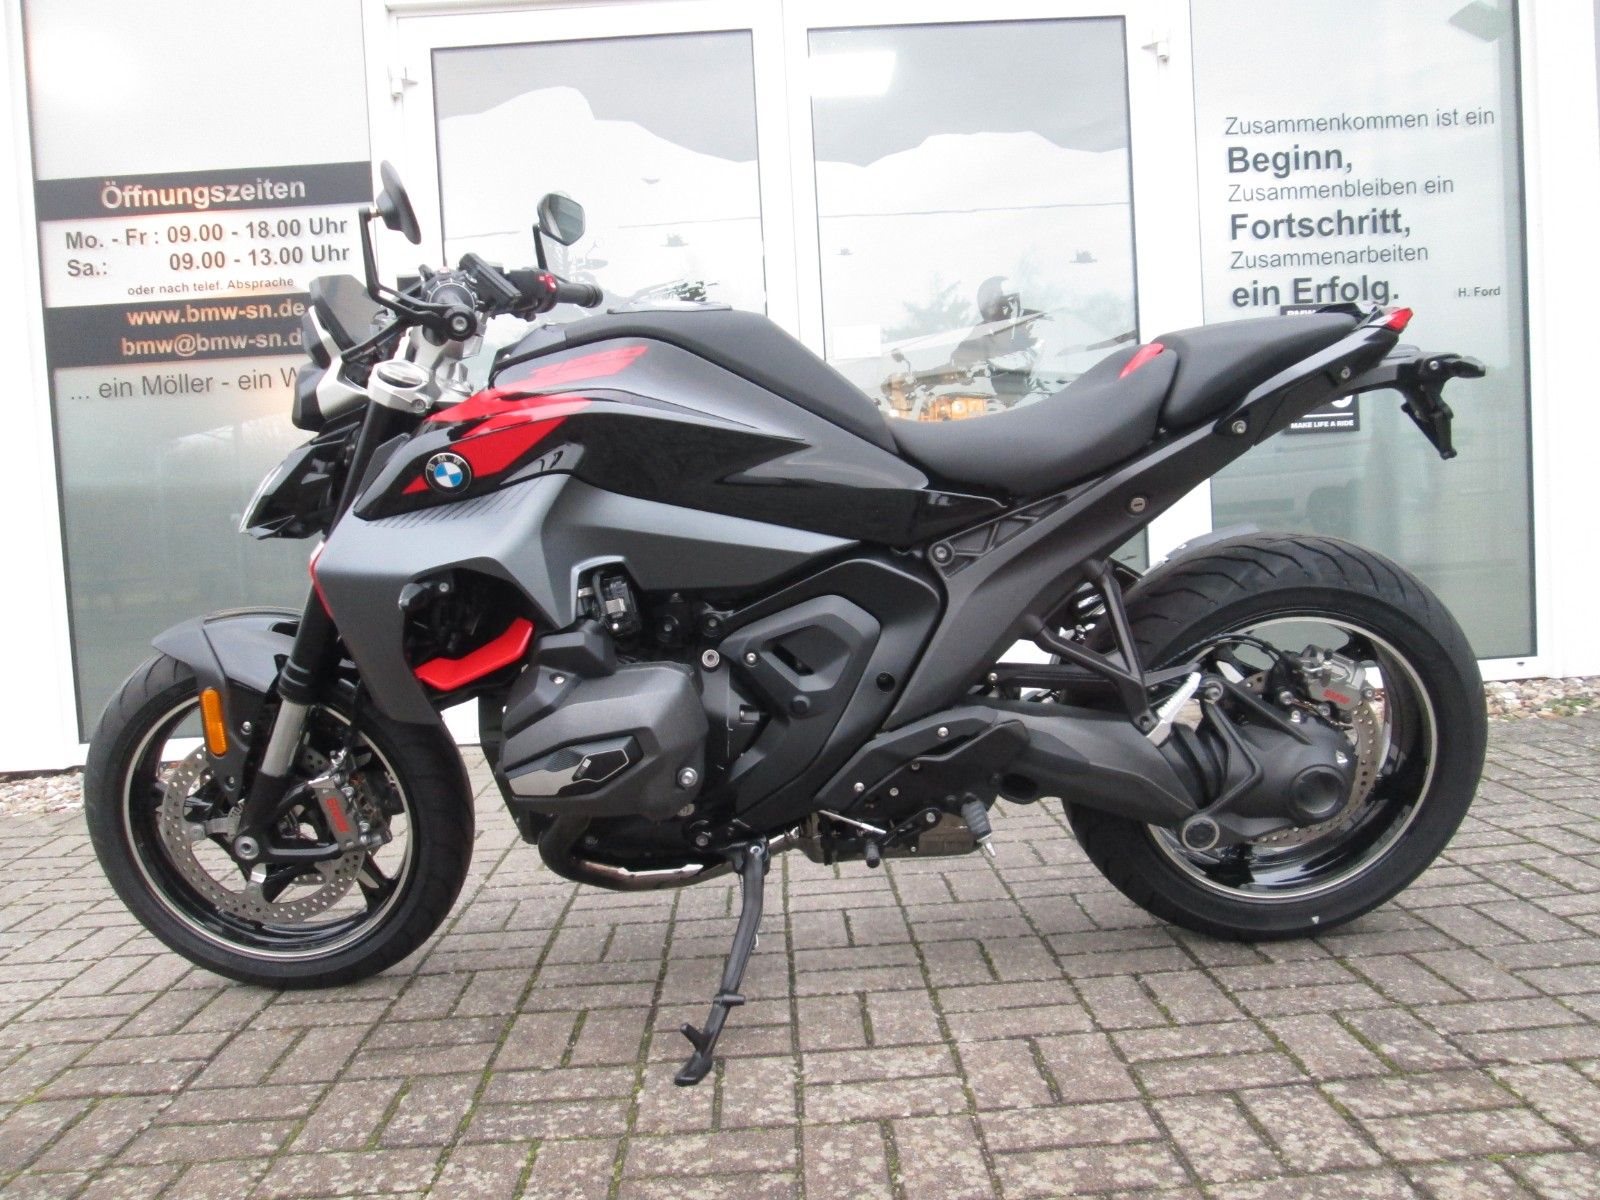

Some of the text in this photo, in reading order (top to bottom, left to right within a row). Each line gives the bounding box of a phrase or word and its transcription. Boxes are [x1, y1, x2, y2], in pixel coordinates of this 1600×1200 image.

[1225, 107, 1495, 135] Zusammenkommen ist ein
[1228, 144, 1352, 178] Beginn,
[101, 177, 306, 209] Öffnungszeiten
[1228, 175, 1454, 202] Zusammenbleiben ein
[65, 231, 104, 250] Mo.
[167, 223, 223, 244] 09.00
[246, 219, 301, 239] 18.00
[309, 217, 348, 235] Uhr
[1231, 207, 1410, 240] Fortschritt,
[169, 251, 226, 271] 09.00
[248, 246, 304, 267] 13.00
[311, 244, 350, 263] Uhr
[1230, 244, 1429, 269] Zusammenarbeiten
[127, 277, 294, 296] oder nach telef. Absprache
[1232, 275, 1399, 308] ein Erfolg.
[1457, 285, 1501, 298] H. Ford
[126, 298, 306, 326] www.bmw-sn.de
[121, 327, 302, 357] bmw@bmw-sn.d
[98, 377, 133, 398] ein
[141, 372, 214, 397] Möller
[238, 369, 272, 390] ein
[1290, 421, 1313, 429] MAKE
[1313, 420, 1329, 428] LIFE
[1336, 419, 1354, 427] RIDE
